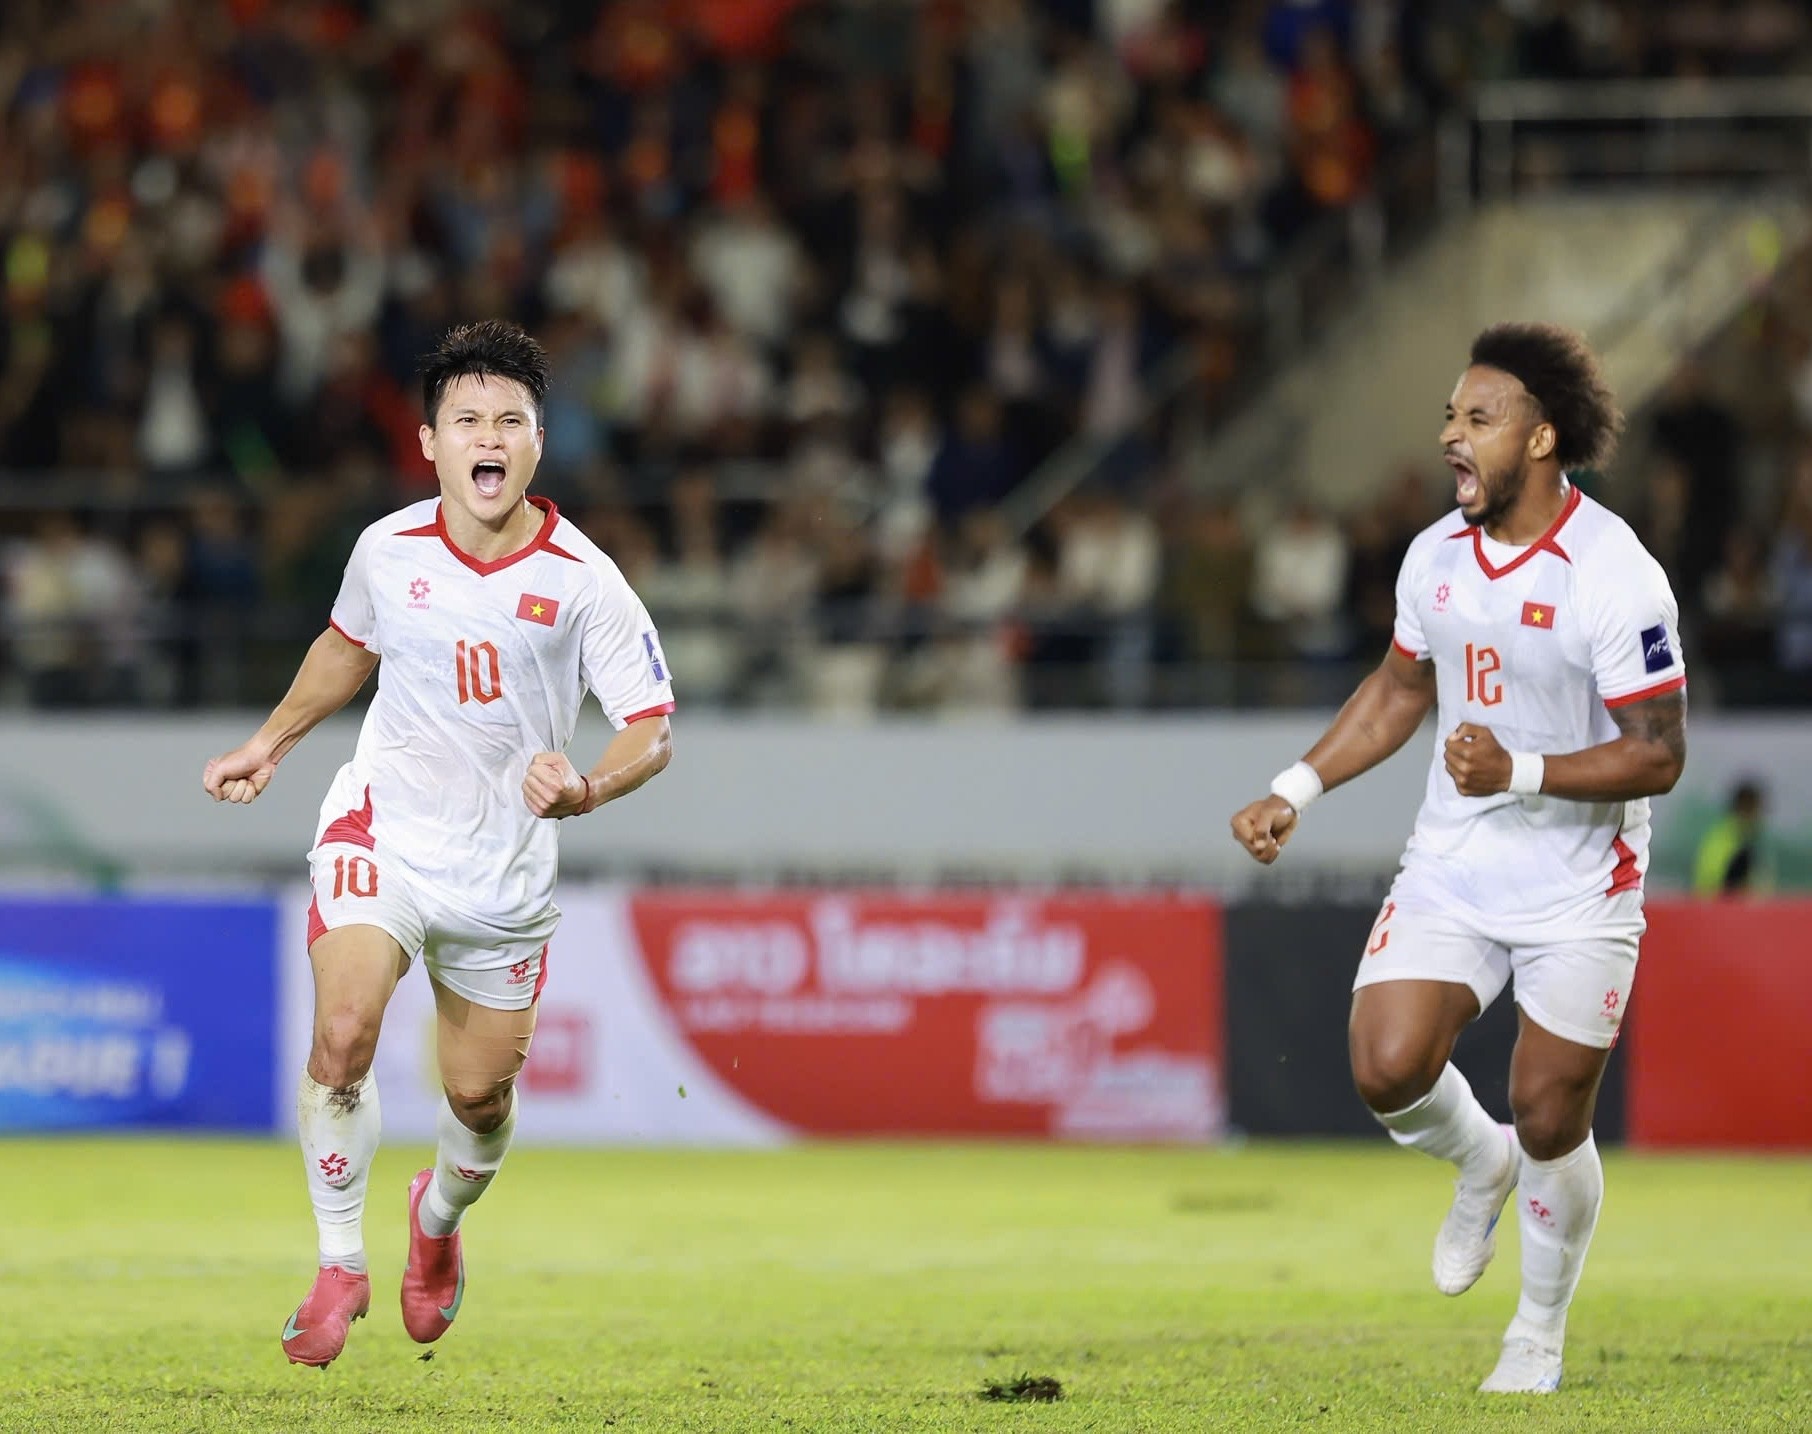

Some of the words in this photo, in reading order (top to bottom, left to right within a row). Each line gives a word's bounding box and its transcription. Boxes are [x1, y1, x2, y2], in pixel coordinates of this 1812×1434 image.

[455, 638, 502, 705] 10
[1465, 641, 1502, 707] 12
[332, 854, 378, 900] 10
